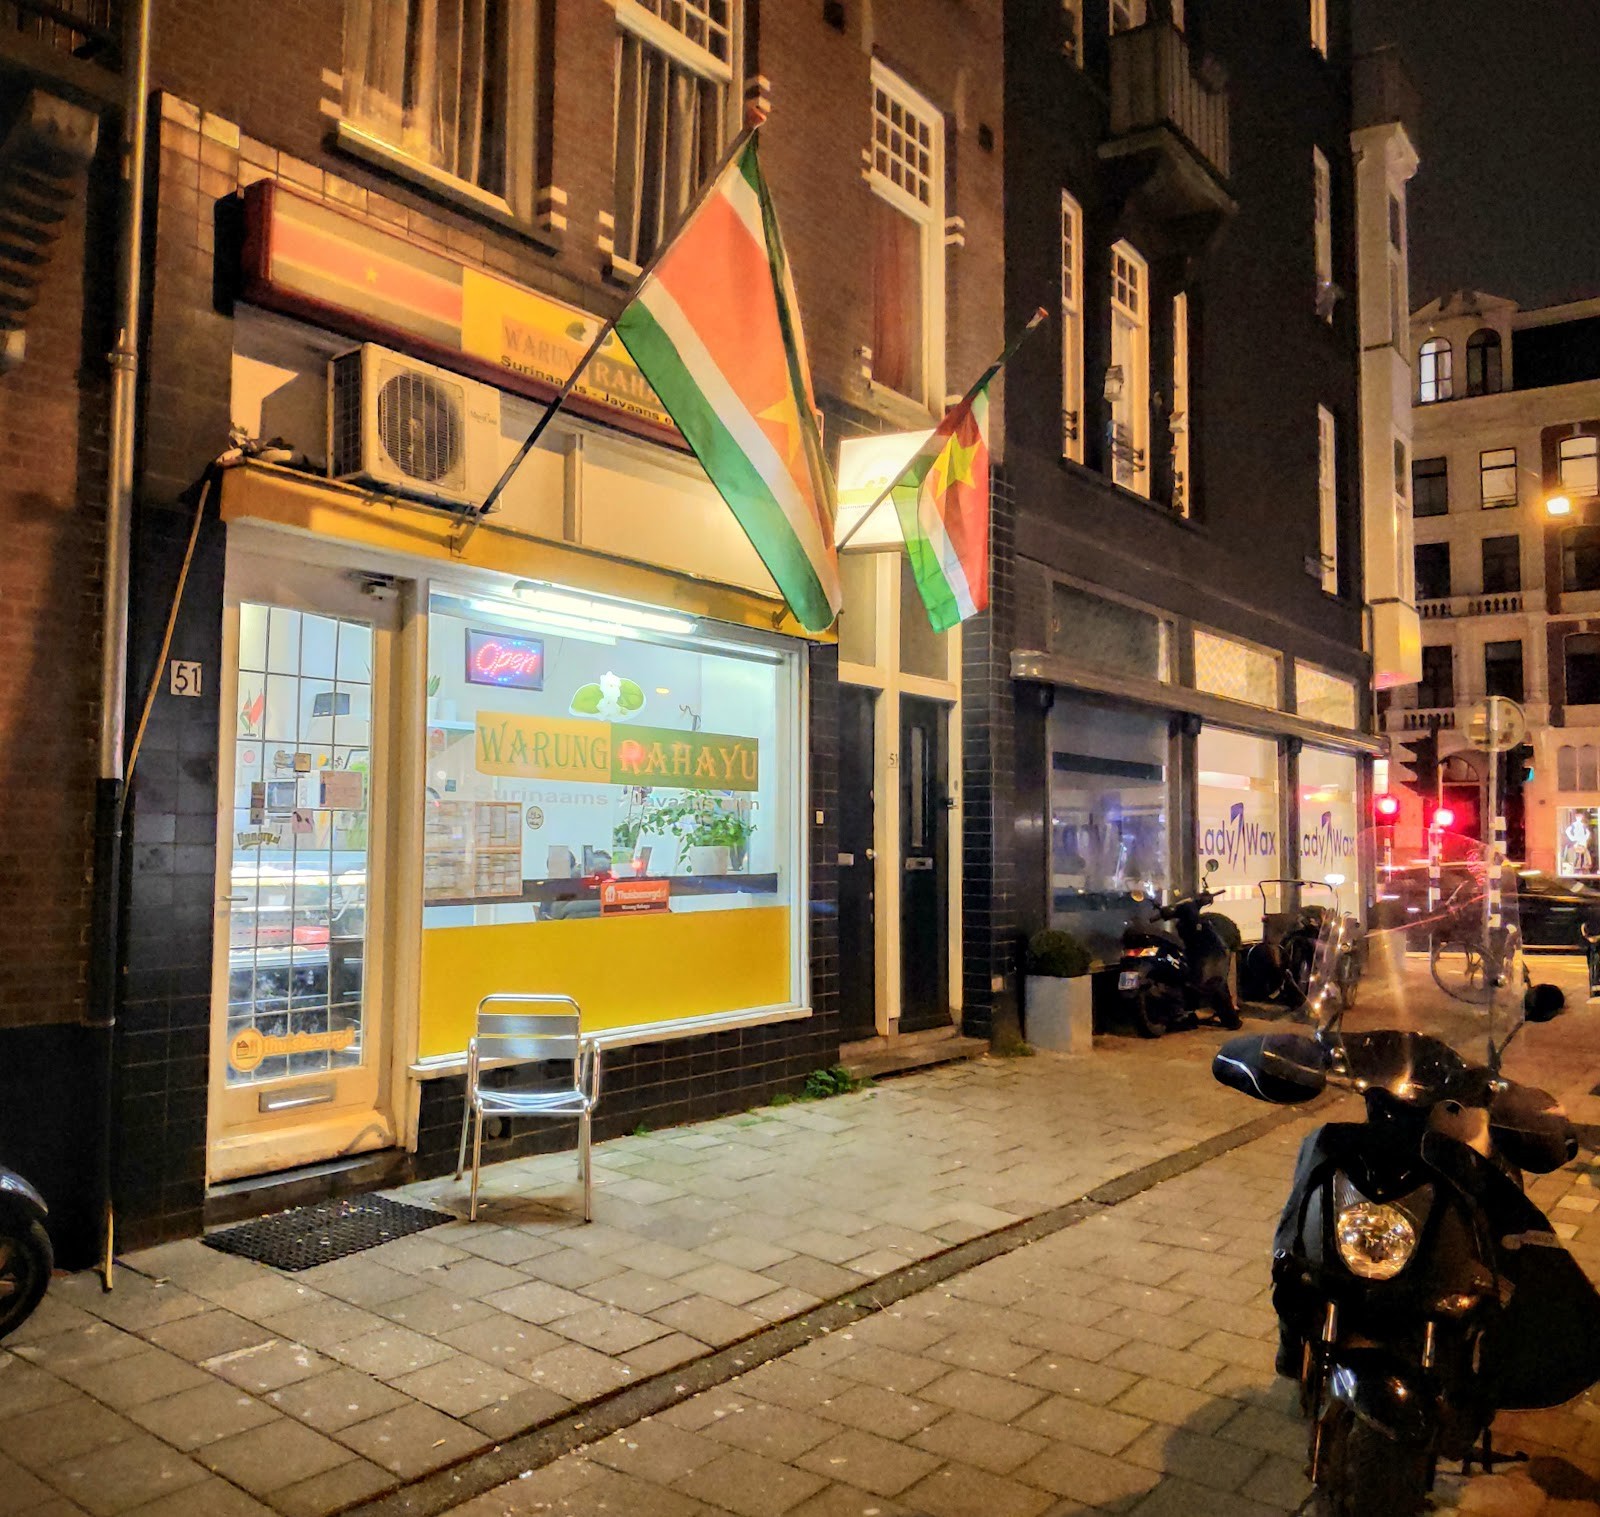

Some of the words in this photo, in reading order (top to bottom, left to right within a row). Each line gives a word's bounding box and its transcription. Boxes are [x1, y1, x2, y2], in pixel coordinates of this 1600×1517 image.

[602, 393, 660, 420] Javaans
[476, 642, 537, 677] Open
[174, 664, 199, 693] 51
[479, 720, 608, 770] WARUNG
[620, 739, 757, 781] RAHAYU
[474, 785, 608, 805] Surinaams
[1197, 819, 1234, 865] Lady
[1246, 822, 1277, 856] Wax
[1333, 828, 1355, 858] Wax
